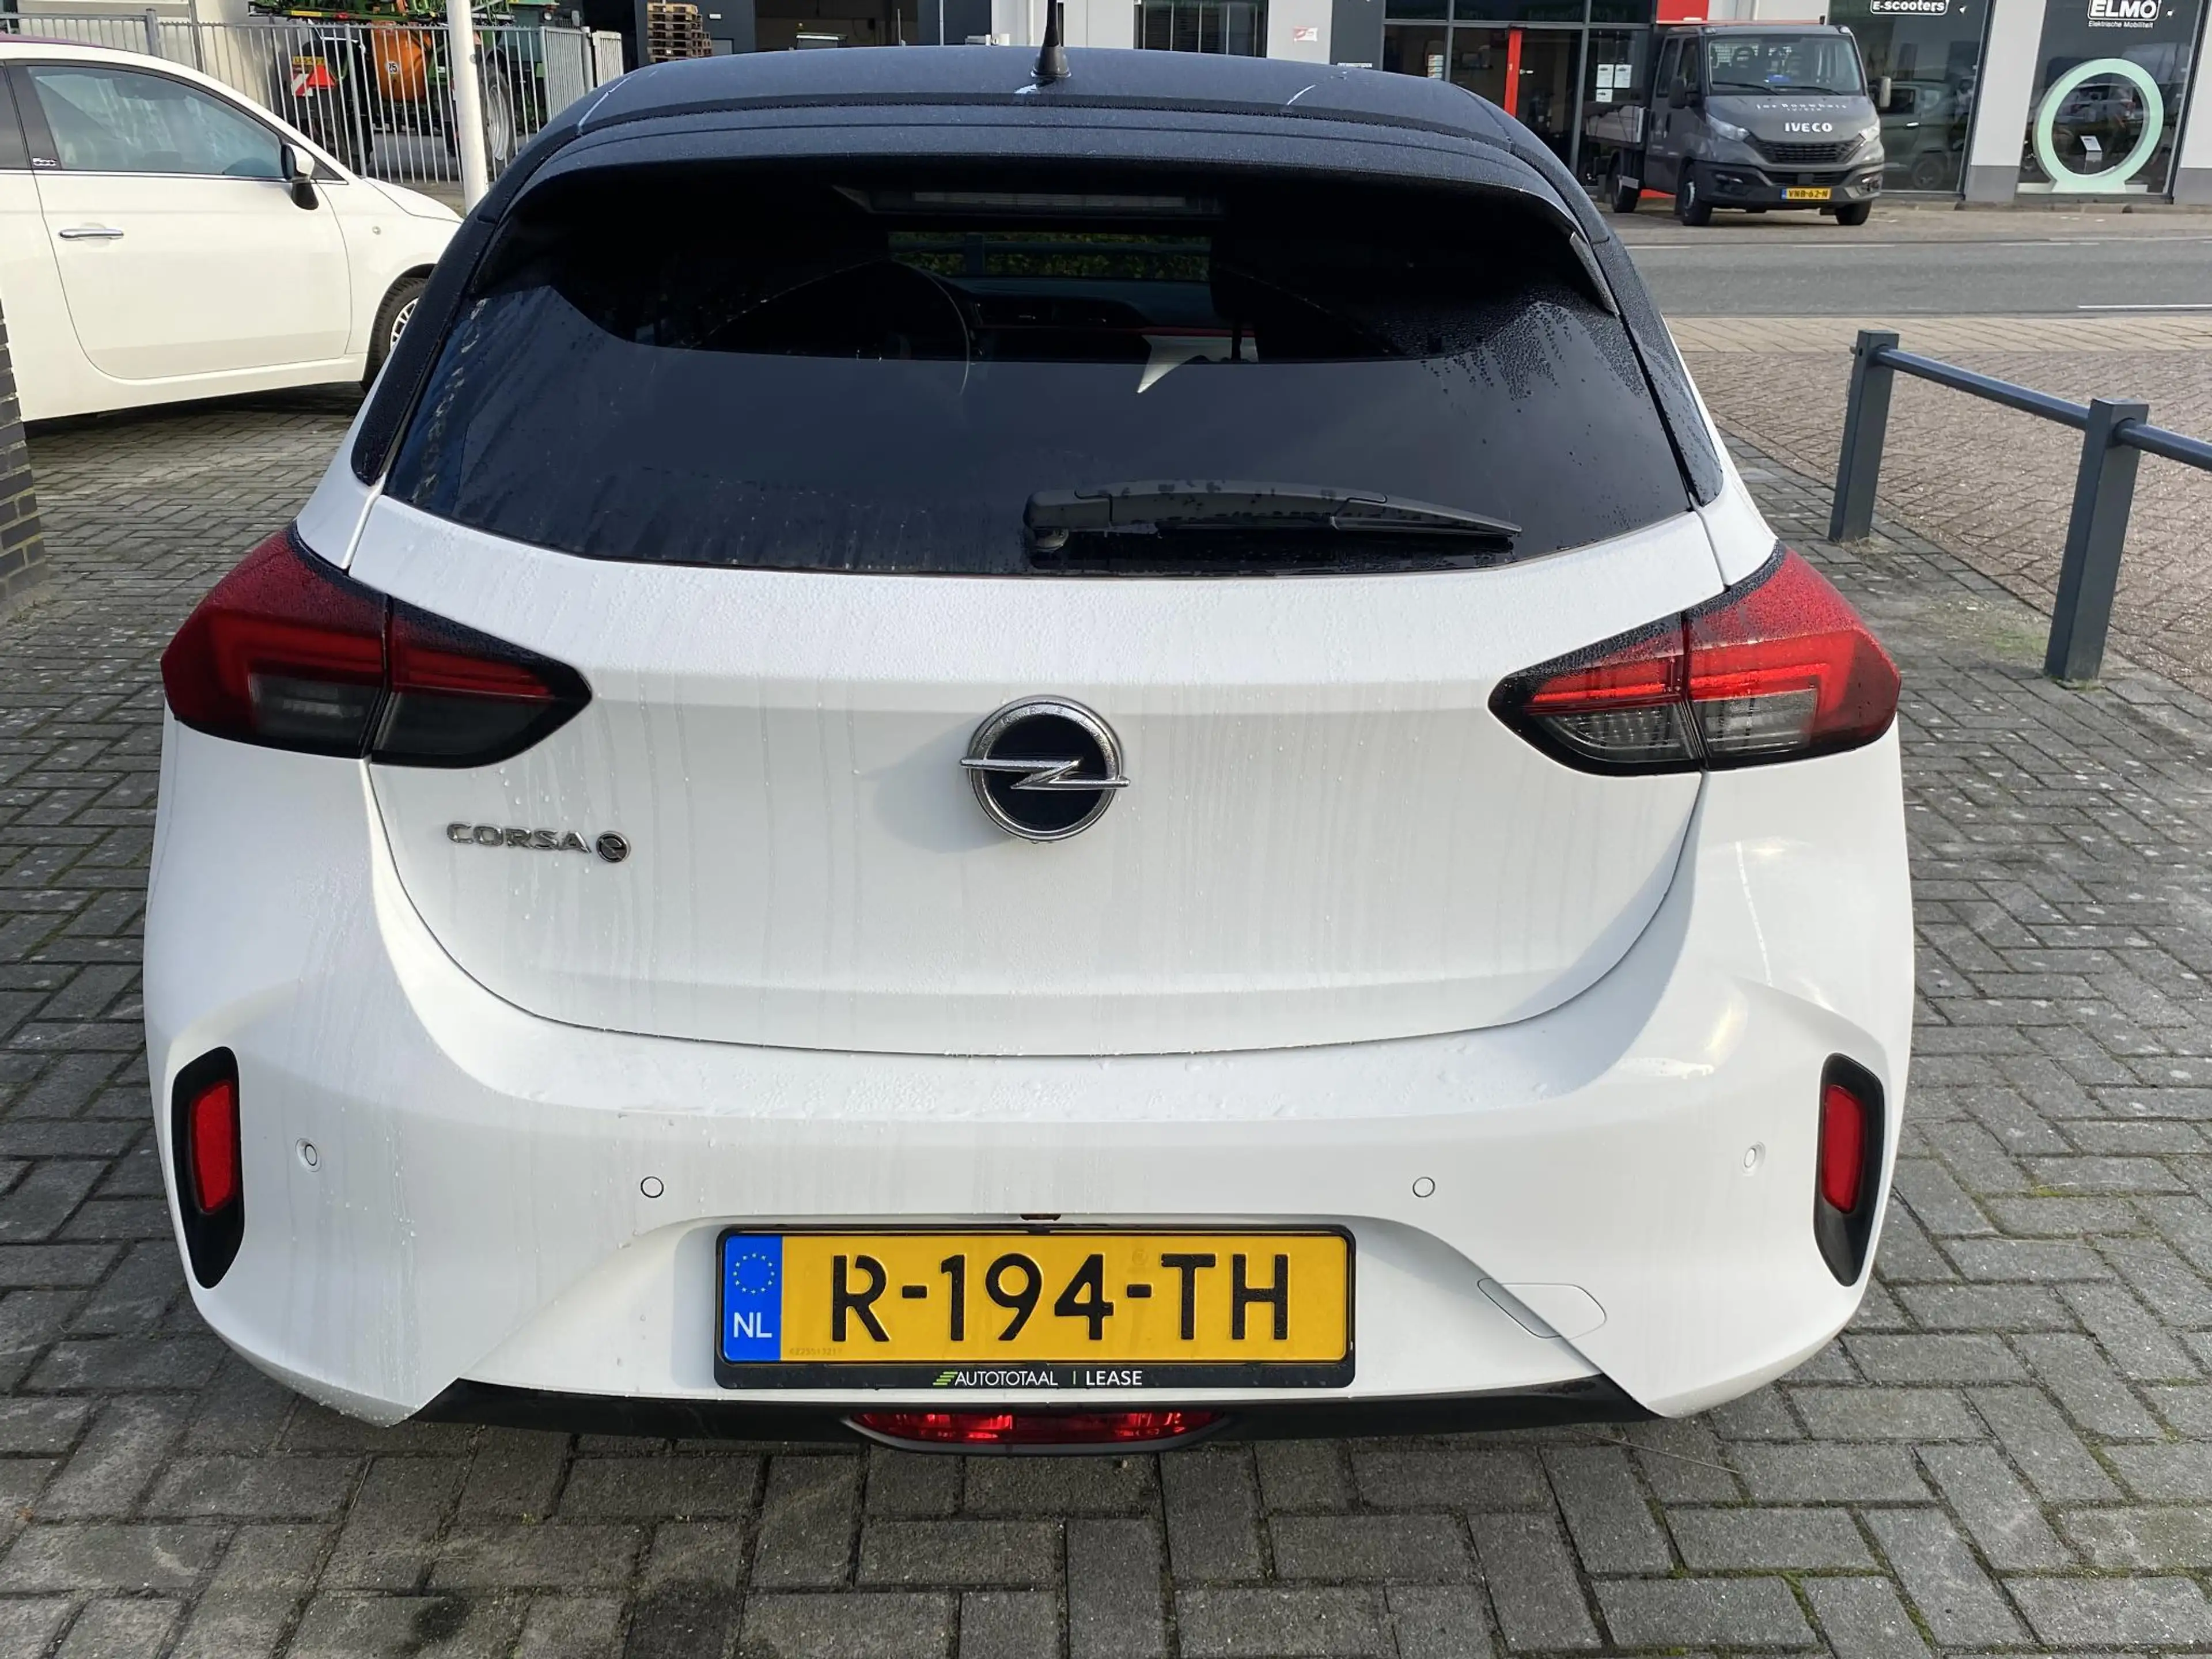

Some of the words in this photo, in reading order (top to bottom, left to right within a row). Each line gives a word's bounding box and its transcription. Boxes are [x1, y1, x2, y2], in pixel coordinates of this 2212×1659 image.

[2090, 0, 2157, 18] ELMO
[1785, 122, 1833, 132] IVECO
[446, 820, 592, 854] CORSA
[832, 1252, 1289, 1342] R-194-TH
[733, 1311, 773, 1338] NL
[954, 1370, 1058, 1386] AUTOTOTAAL
[1086, 1370, 1143, 1386] LEASE
